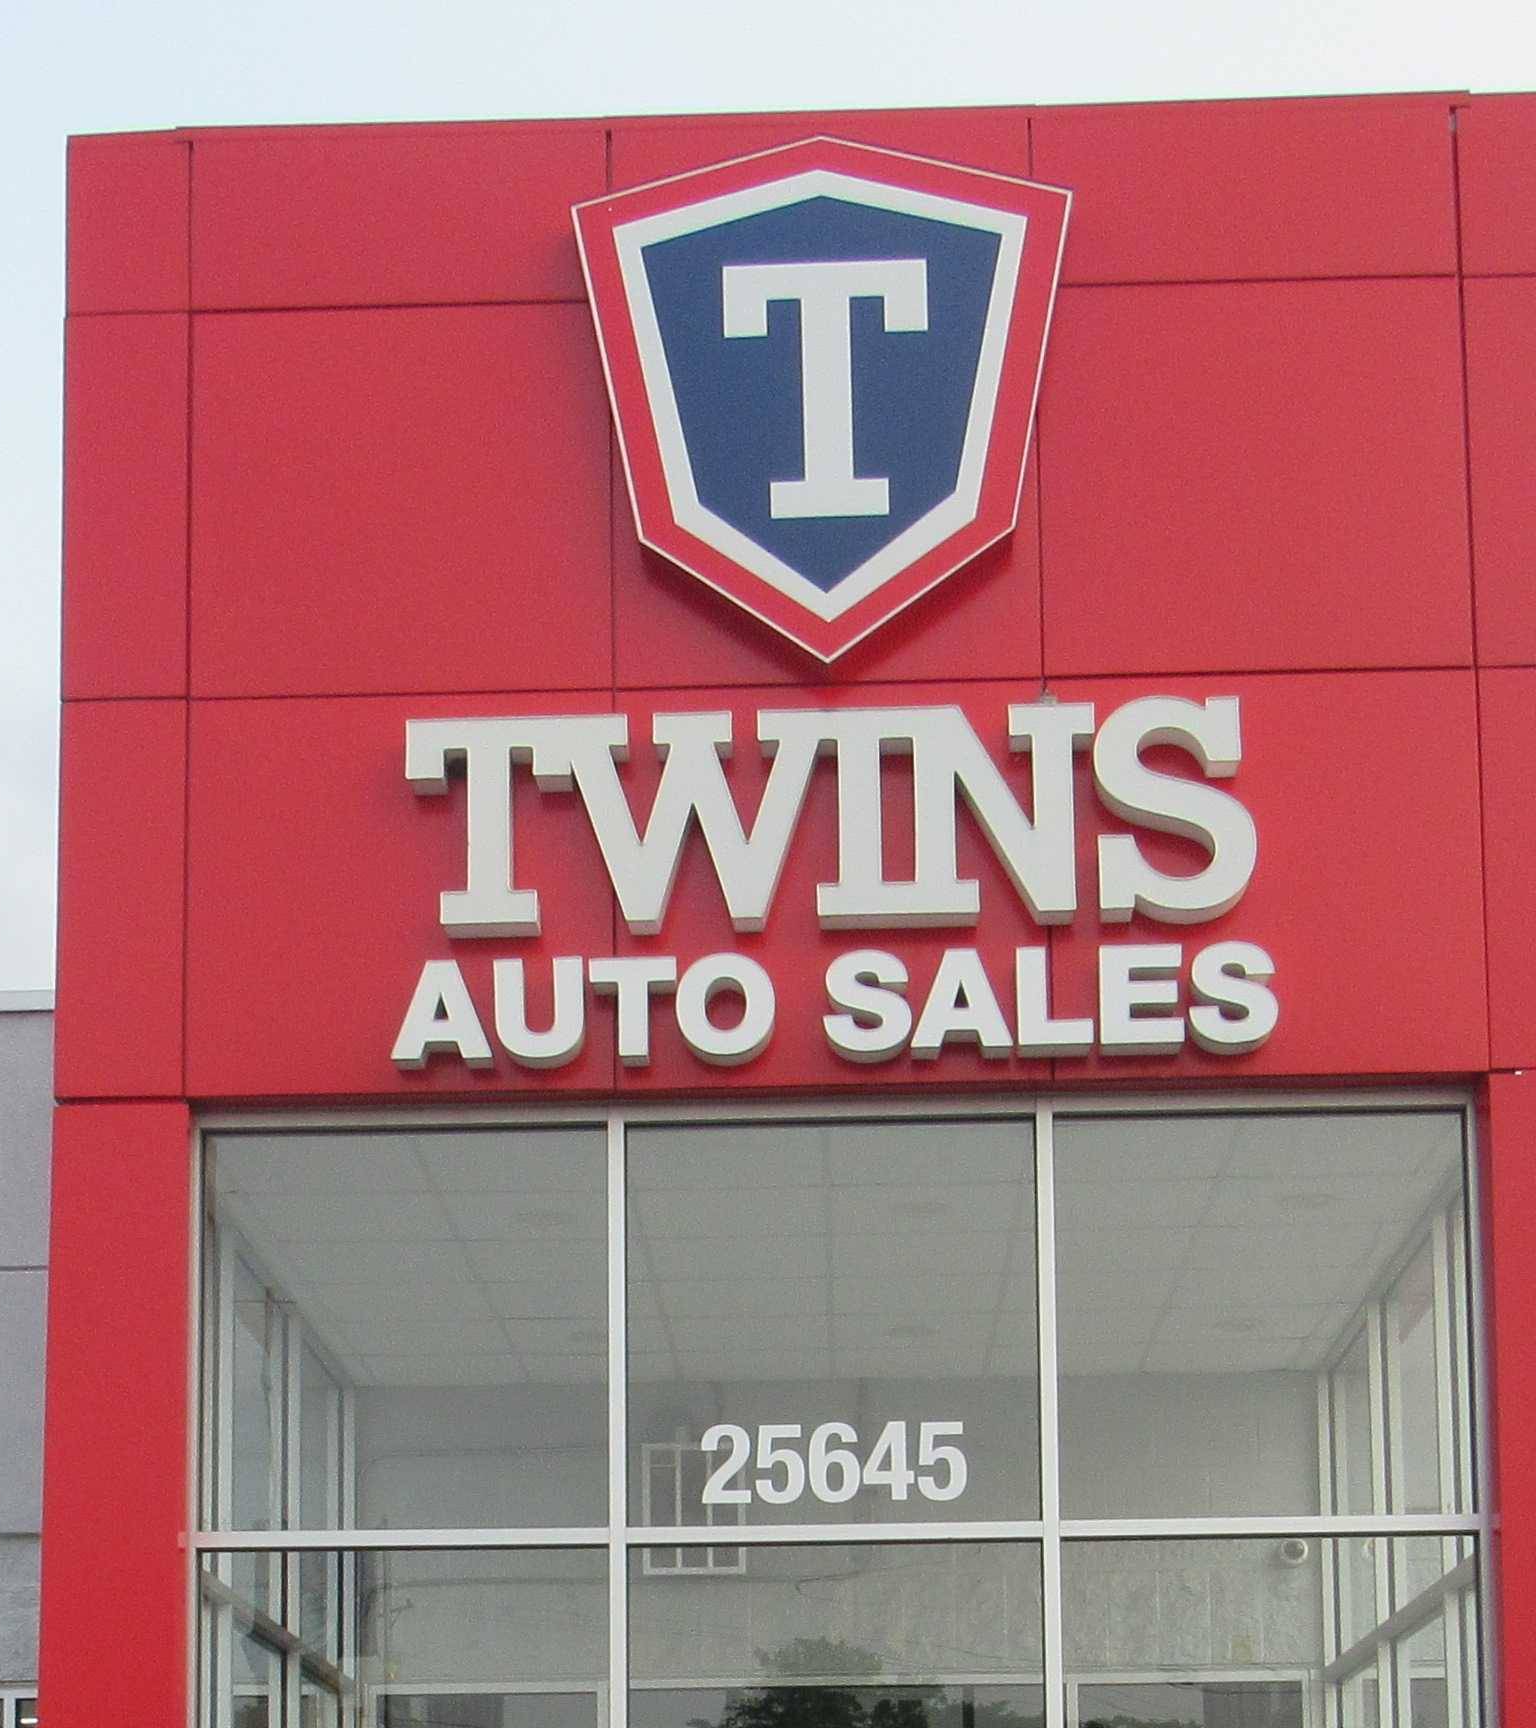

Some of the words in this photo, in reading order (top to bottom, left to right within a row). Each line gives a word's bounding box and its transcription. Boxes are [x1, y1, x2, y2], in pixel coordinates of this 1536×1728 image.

[722, 259, 928, 520] T
[405, 696, 1257, 938] TWINS
[390, 952, 775, 1069] AUTO
[822, 943, 1279, 1063] SALES
[700, 1421, 967, 1504] 25645
